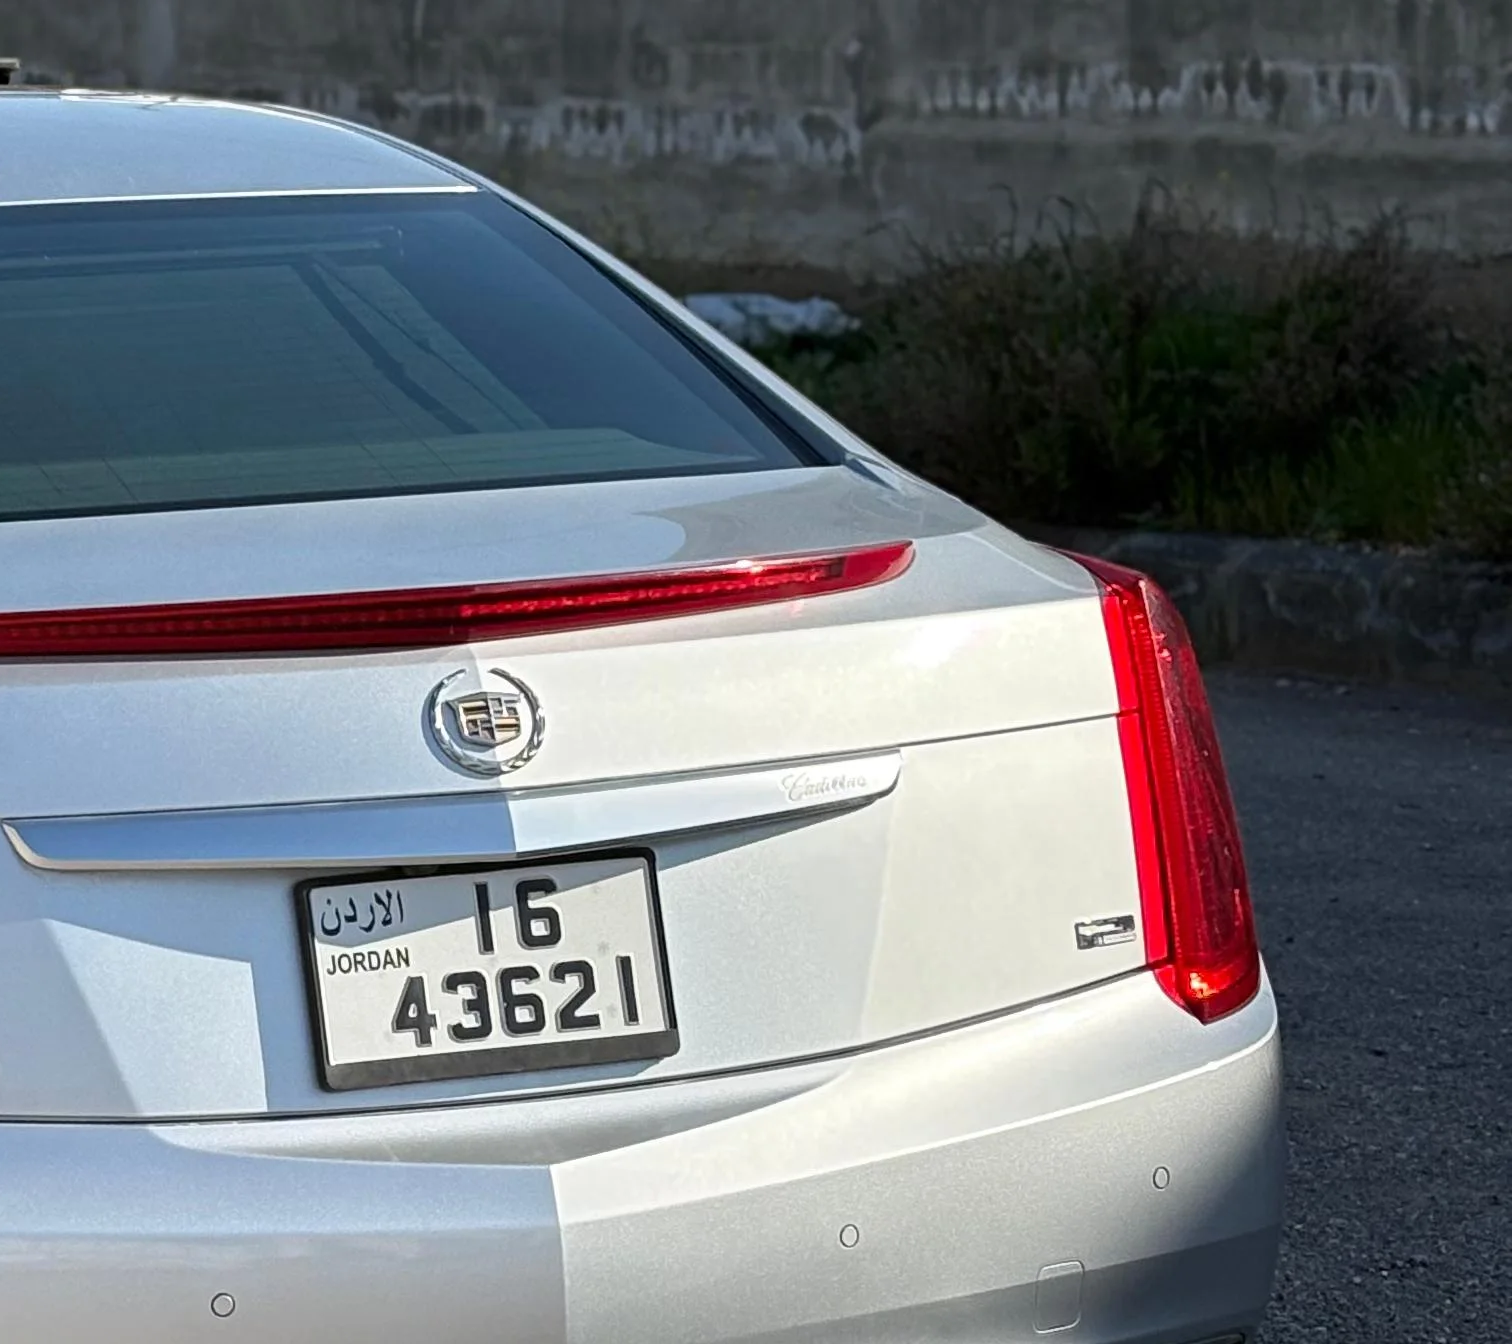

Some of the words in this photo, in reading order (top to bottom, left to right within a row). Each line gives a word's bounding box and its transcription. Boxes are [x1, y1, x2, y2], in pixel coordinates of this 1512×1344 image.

[319, 889, 404, 937] الاردن
[473, 876, 561, 954] 16
[326, 947, 410, 976] JORDAN
[391, 956, 639, 1047] 43621
